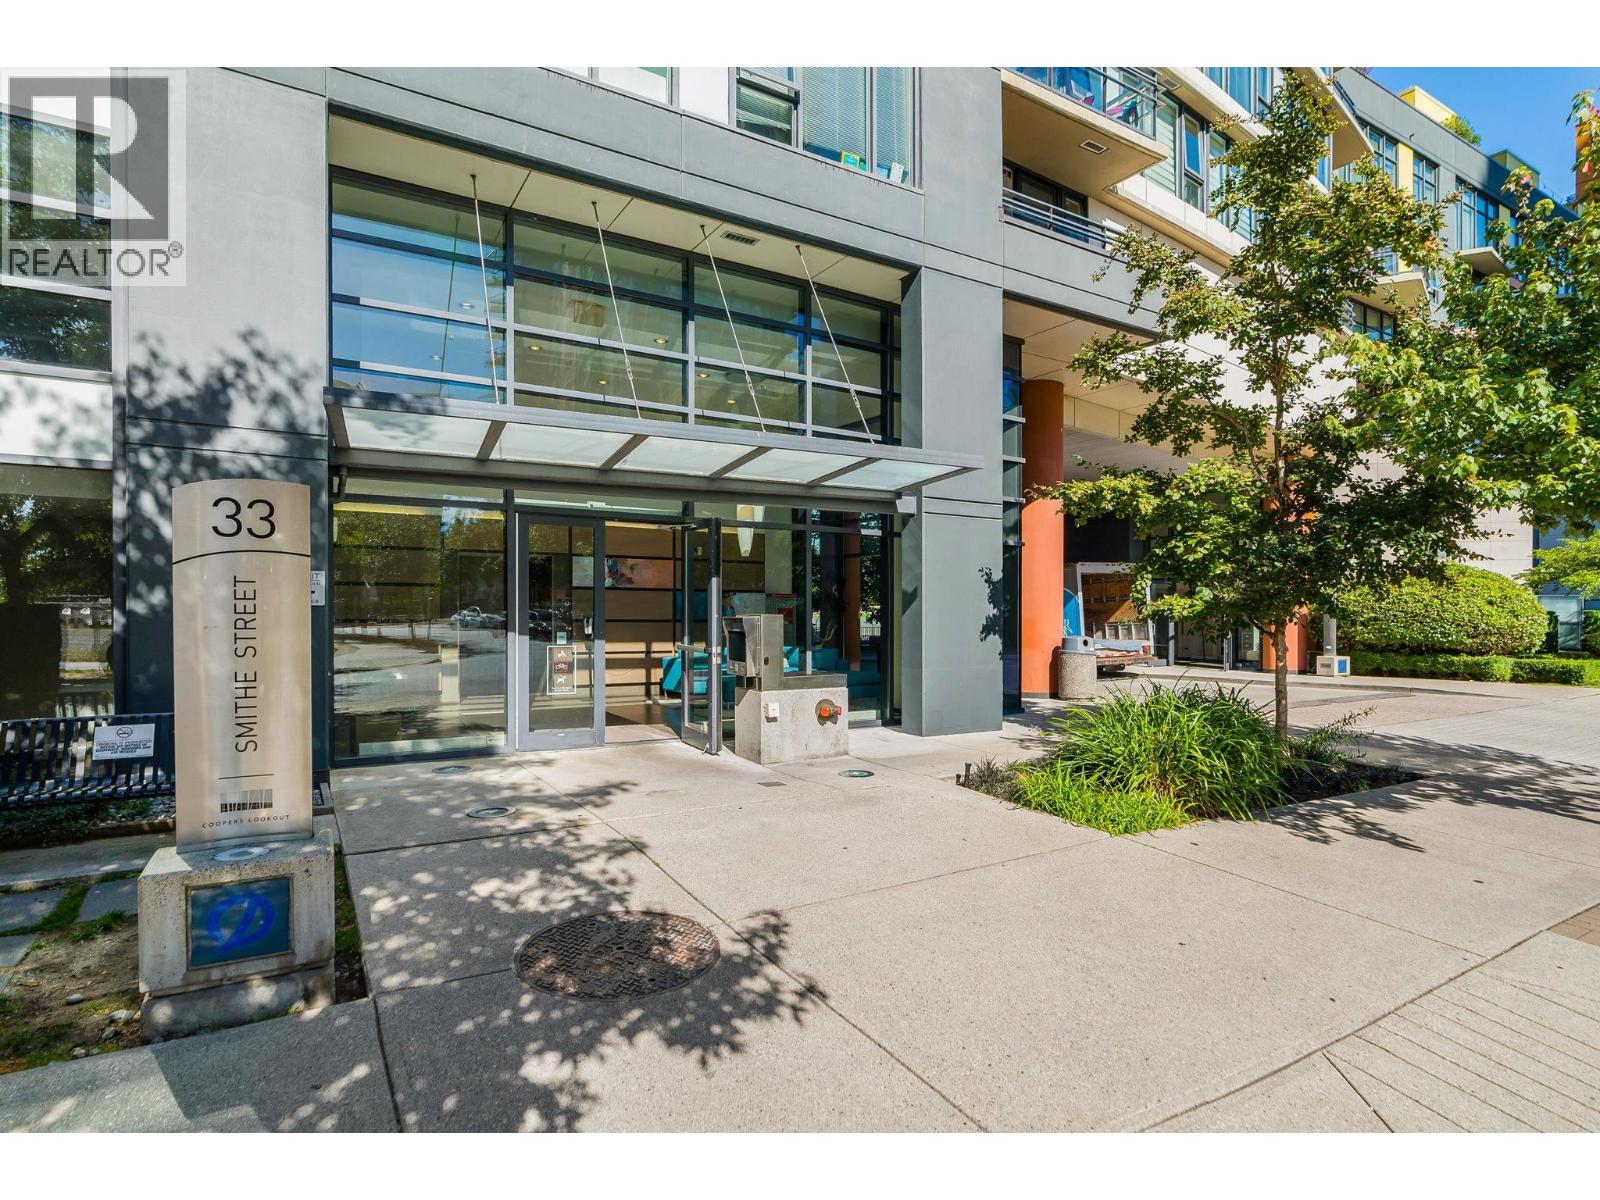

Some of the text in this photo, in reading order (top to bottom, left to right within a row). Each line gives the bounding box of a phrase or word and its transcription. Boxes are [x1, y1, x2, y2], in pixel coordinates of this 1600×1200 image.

[212, 497, 276, 539] 33
[233, 575, 258, 753] SMITHE STREET
[202, 814, 290, 829] COOPERS LOOKOUT
